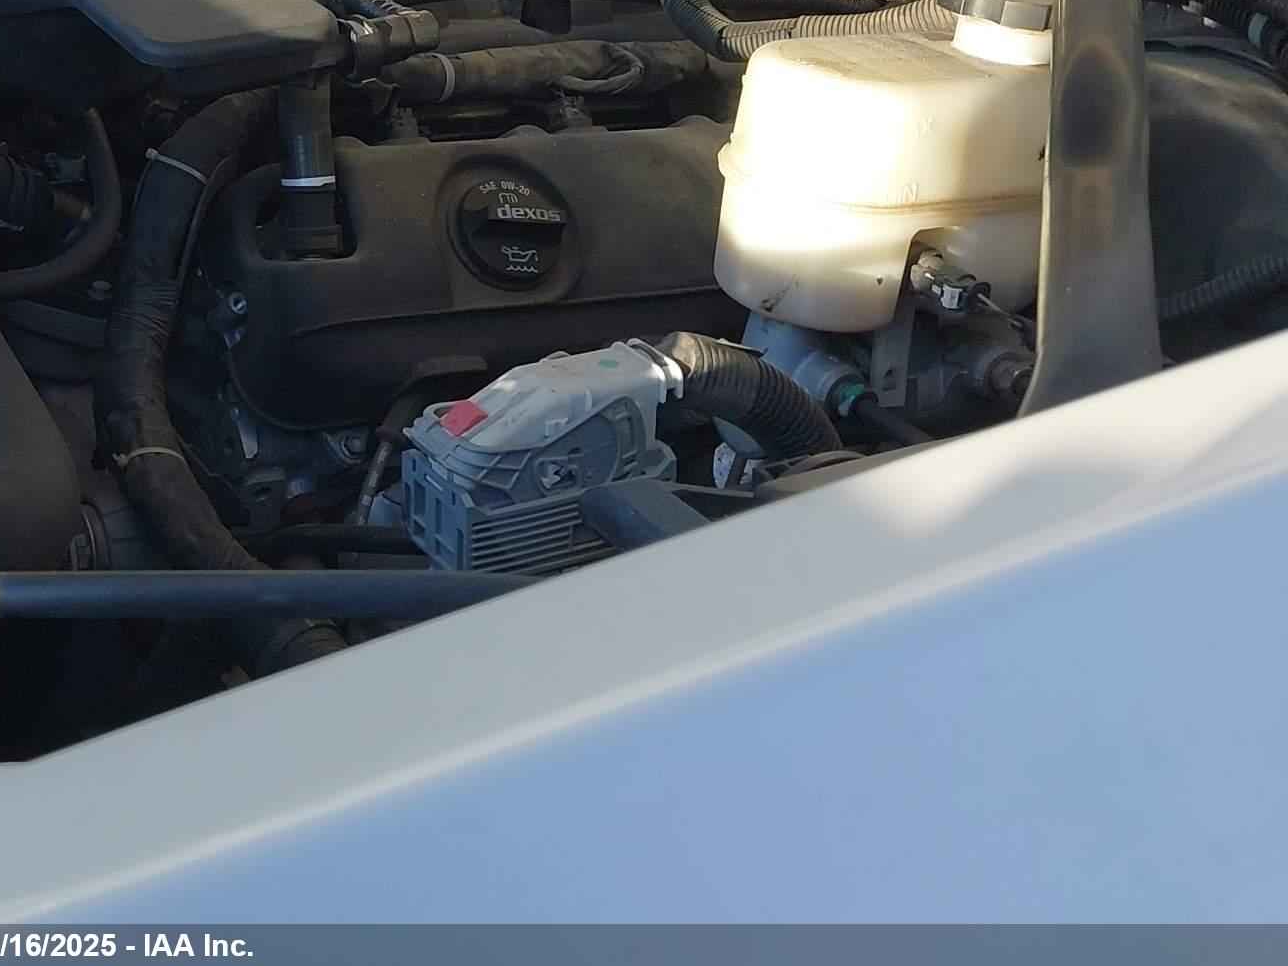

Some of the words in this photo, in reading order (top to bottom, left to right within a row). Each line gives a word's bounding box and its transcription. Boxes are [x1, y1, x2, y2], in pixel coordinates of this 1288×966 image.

[479, 180, 498, 194] SAE
[500, 180, 530, 196] 0W-20
[497, 204, 561, 221] dexos
